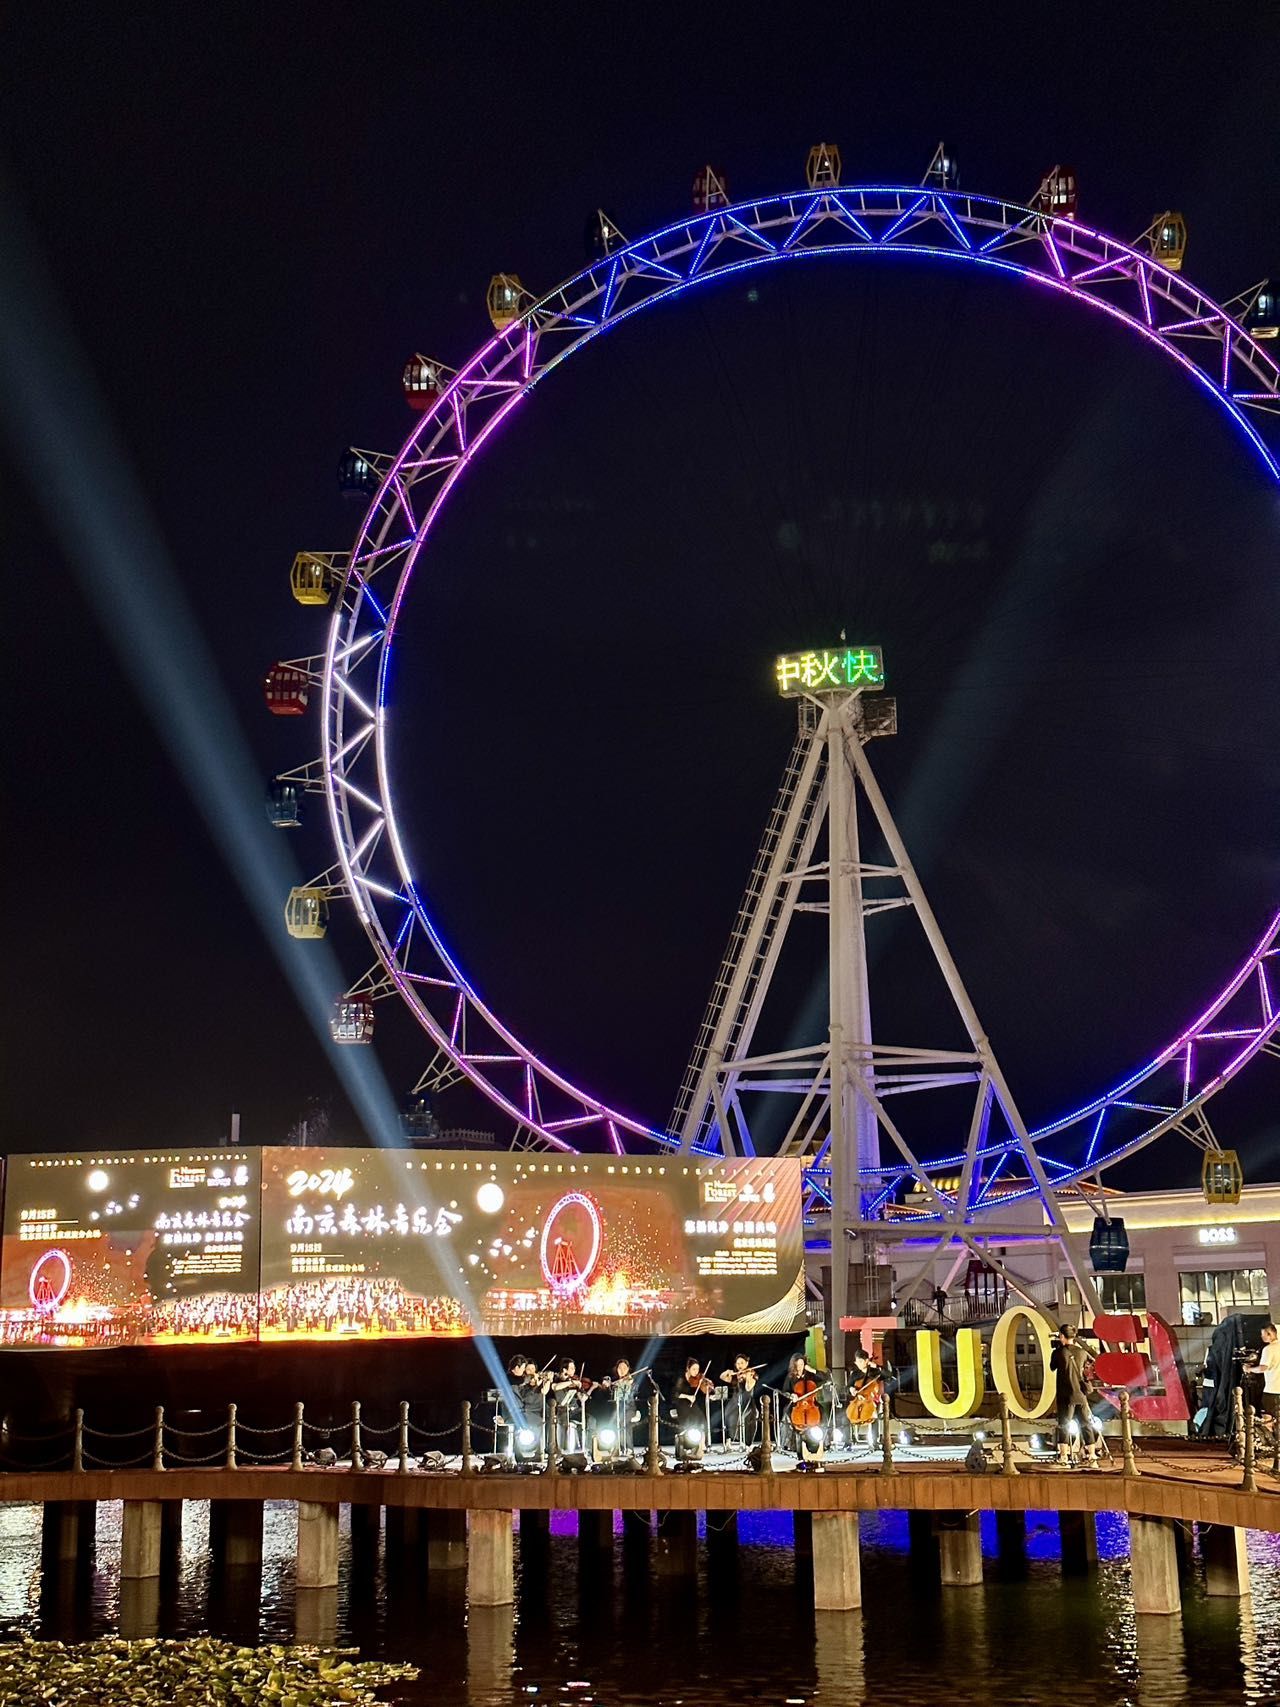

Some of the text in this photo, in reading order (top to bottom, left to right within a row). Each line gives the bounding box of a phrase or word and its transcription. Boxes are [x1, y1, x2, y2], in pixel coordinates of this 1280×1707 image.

[405, 1162, 497, 1171] NANJING
[515, 1164, 590, 1173] FOREST
[607, 1165, 666, 1175] MUSIC
[286, 1167, 354, 1200] 2024
[285, 1203, 464, 1236] 南京森林音乐会
[1198, 1226, 1236, 1243] BOSS
